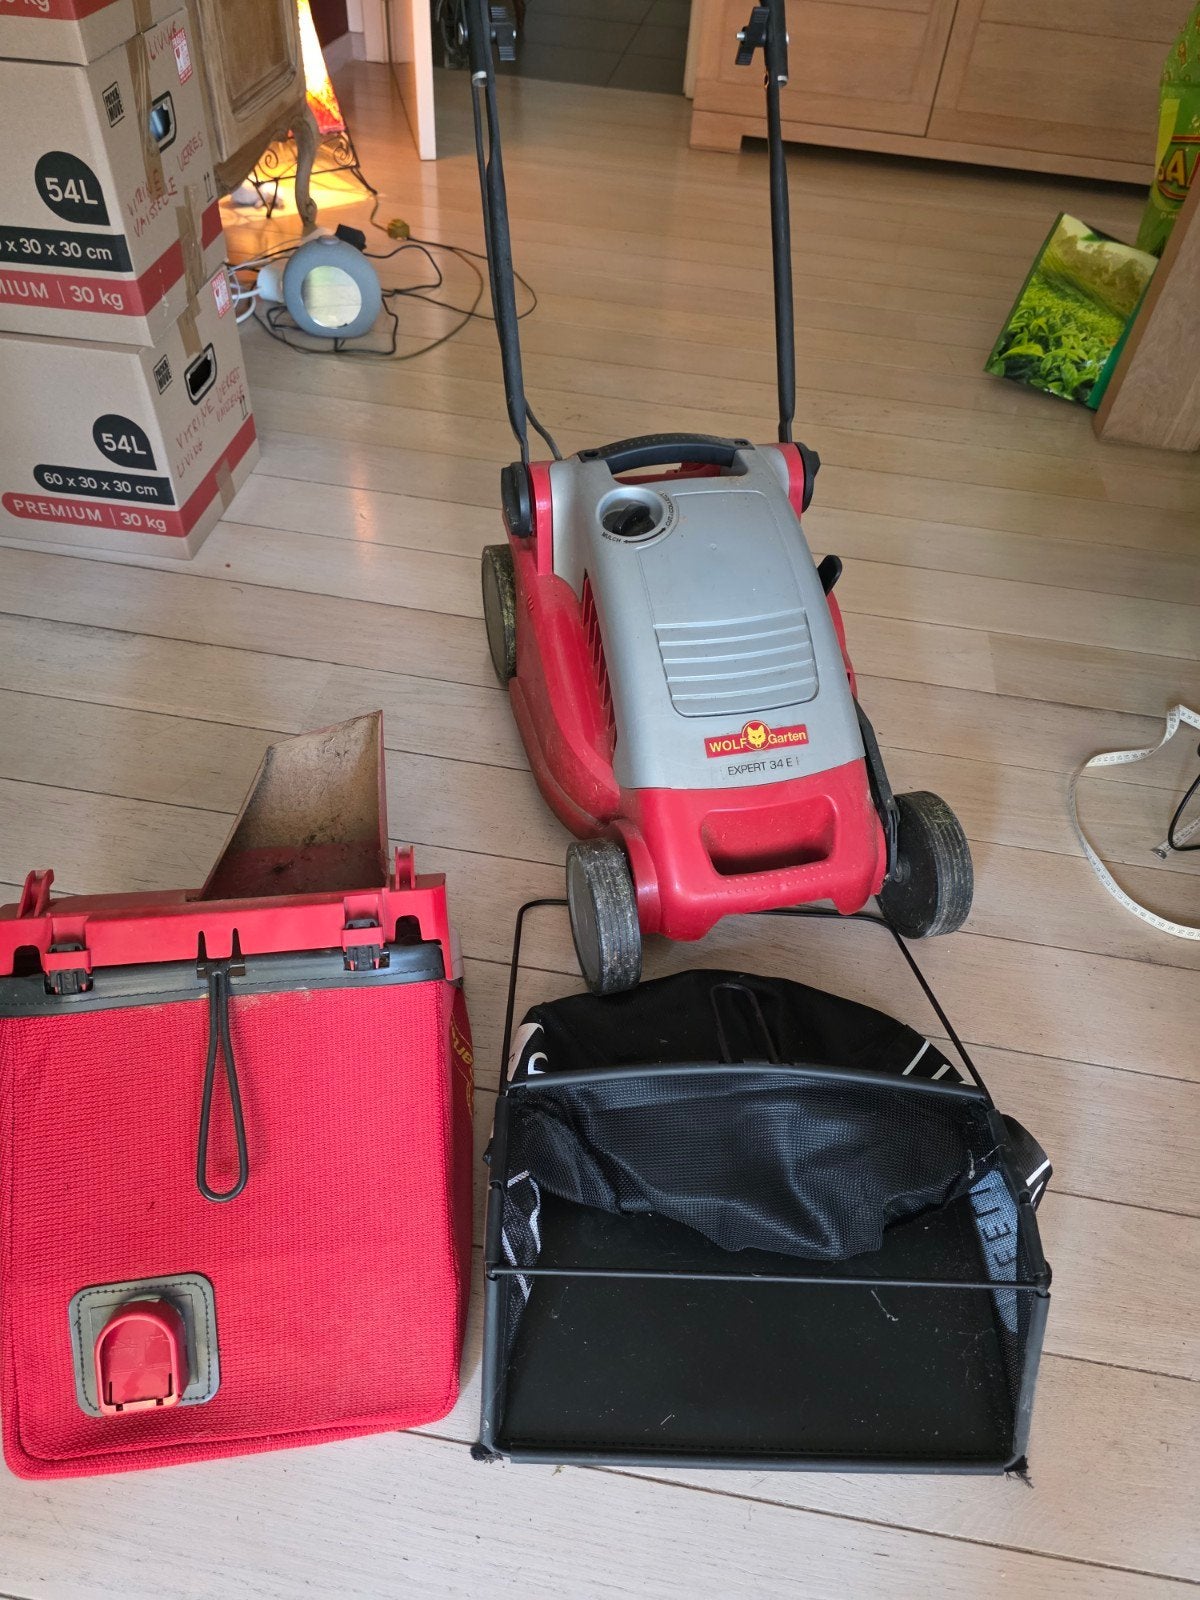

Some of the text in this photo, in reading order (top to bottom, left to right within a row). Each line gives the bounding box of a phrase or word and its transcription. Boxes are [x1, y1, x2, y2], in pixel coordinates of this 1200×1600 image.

[44, 177, 99, 205] 54L
[5, 237, 113, 261] x 30 x 30 cm
[69, 285, 95, 304] 30
[98, 288, 125, 311] kg
[101, 432, 147, 455] 54L
[43, 472, 159, 497] 60 x 30 x 30 cm
[13, 499, 168, 533] PREMIUM 30 kg
[709, 731, 807, 753] WOLF Garten
[727, 761, 767, 776] EXPERT
[769, 758, 784, 771] 34
